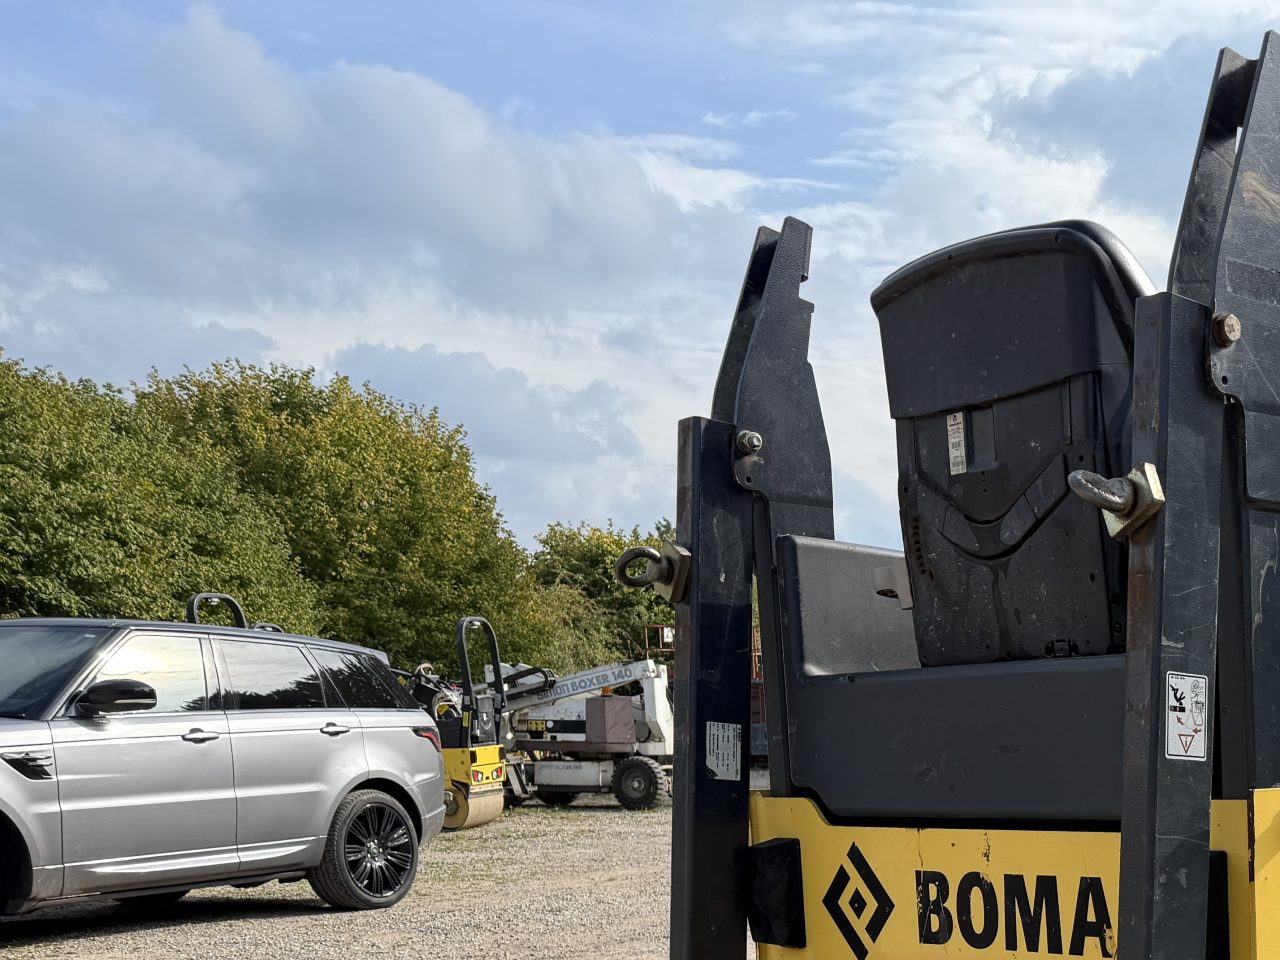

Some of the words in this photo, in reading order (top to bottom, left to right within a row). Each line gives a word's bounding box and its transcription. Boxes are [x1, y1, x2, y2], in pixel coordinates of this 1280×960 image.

[571, 673, 610, 692] BOXER
[612, 668, 633, 682] 140
[914, 869, 1115, 959] BOMA
